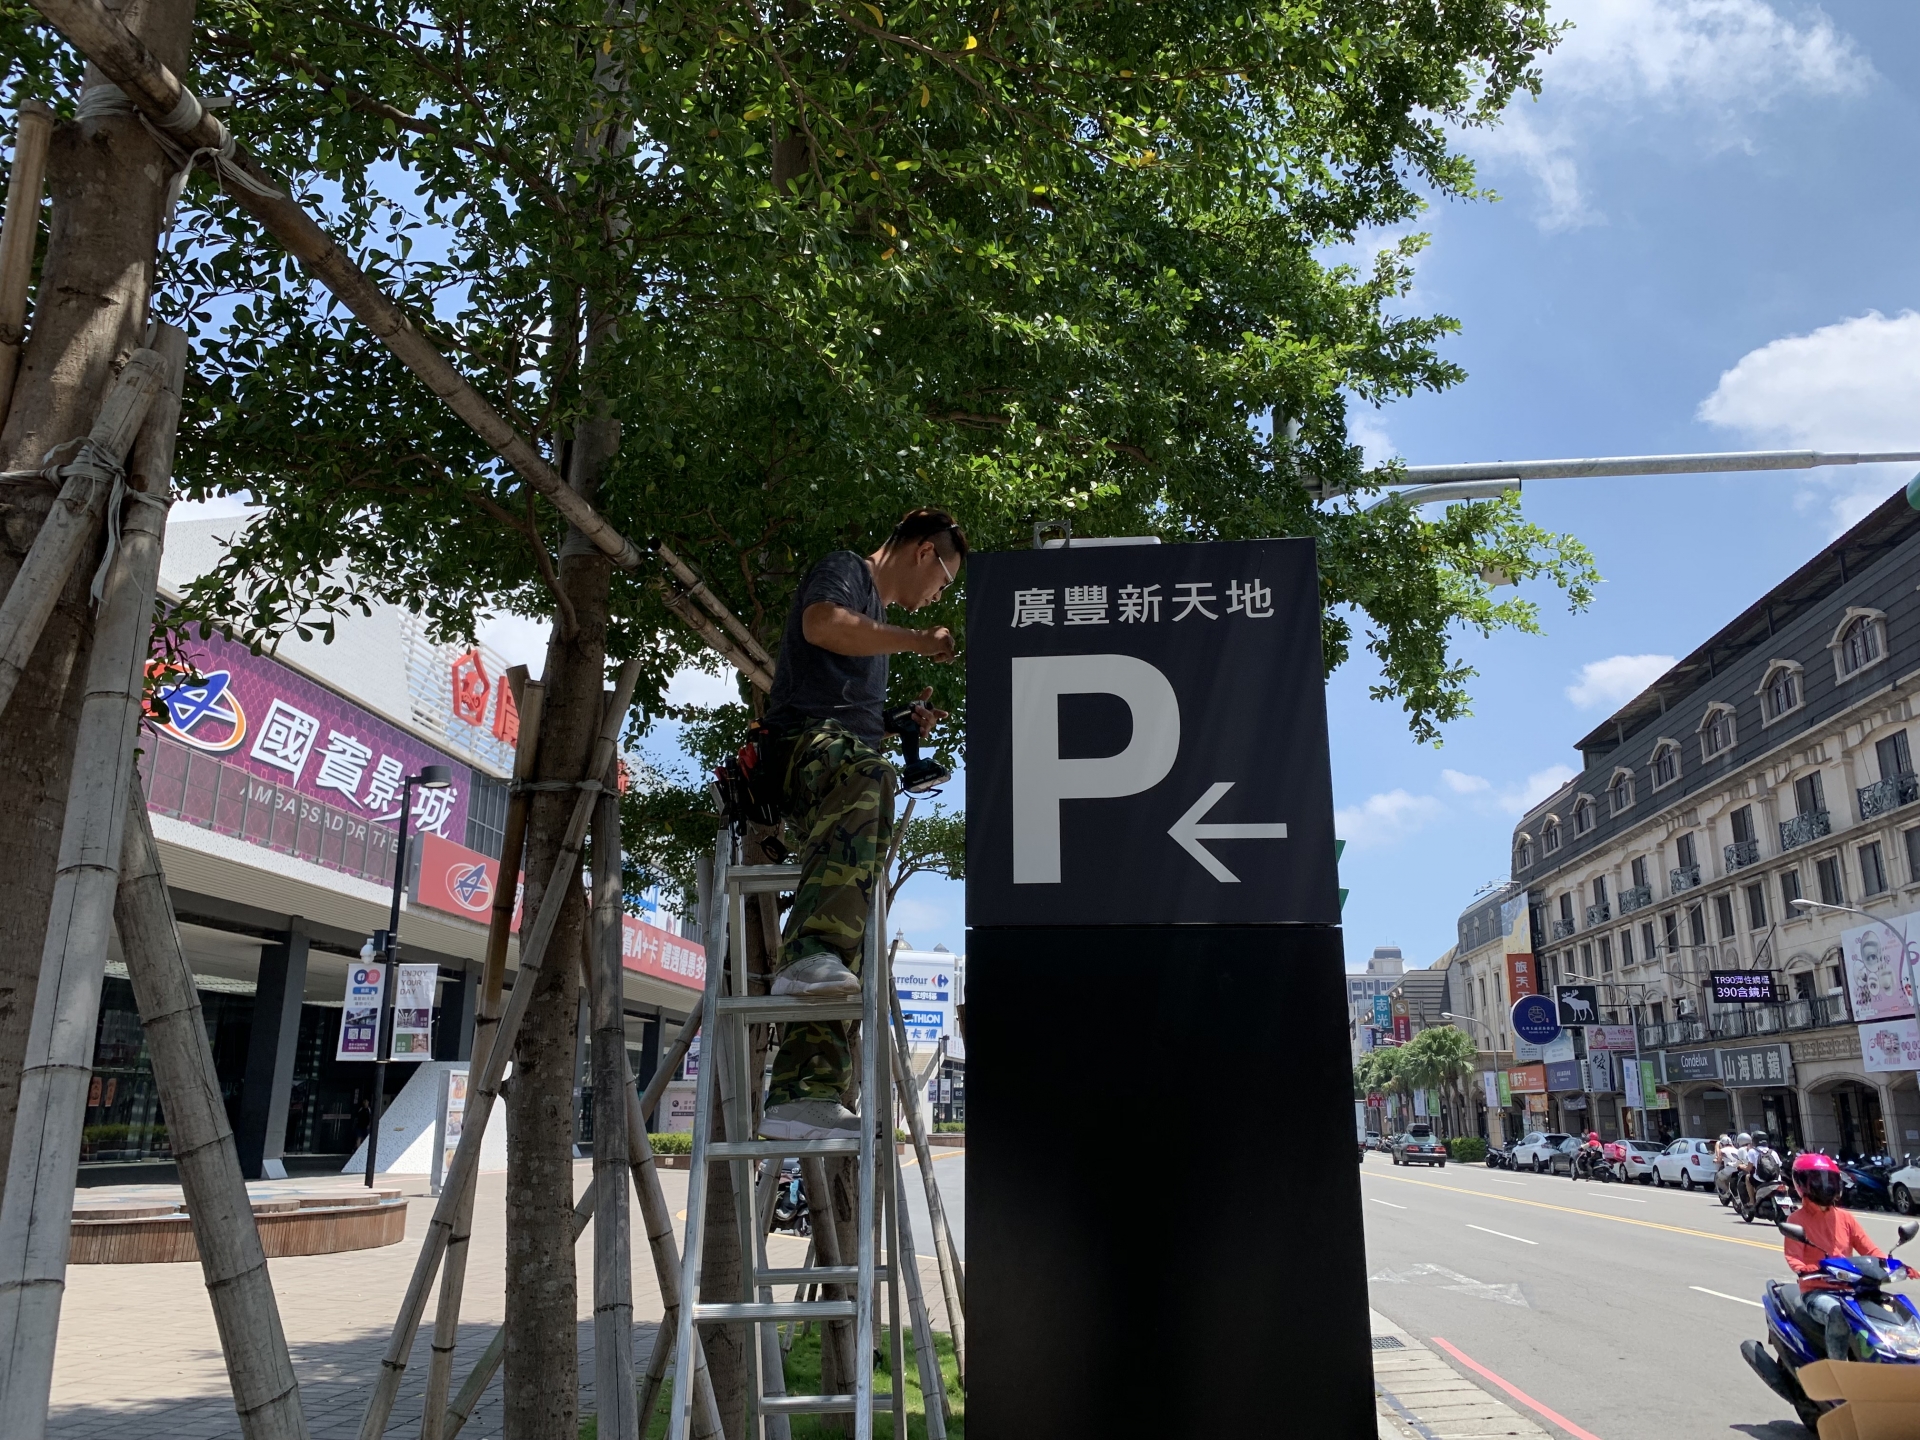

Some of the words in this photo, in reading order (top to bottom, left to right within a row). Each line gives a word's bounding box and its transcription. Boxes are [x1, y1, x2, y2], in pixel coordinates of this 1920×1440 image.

[1011, 578, 1275, 628] 廣豐新天地
[250, 697, 457, 839] 國賓影城
[1012, 653, 1181, 885] P
[240, 782, 367, 841] AMBASSADOR
[622, 926, 659, 964] 賓A+卡
[401, 970, 428, 978] ENJOY
[401, 979, 422, 987] YOUR
[400, 988, 417, 996] DAY
[1376, 998, 1389, 1027] 志光
[1681, 1053, 1709, 1068] Condelux
[1724, 1051, 1782, 1082] 山海眼鏡
